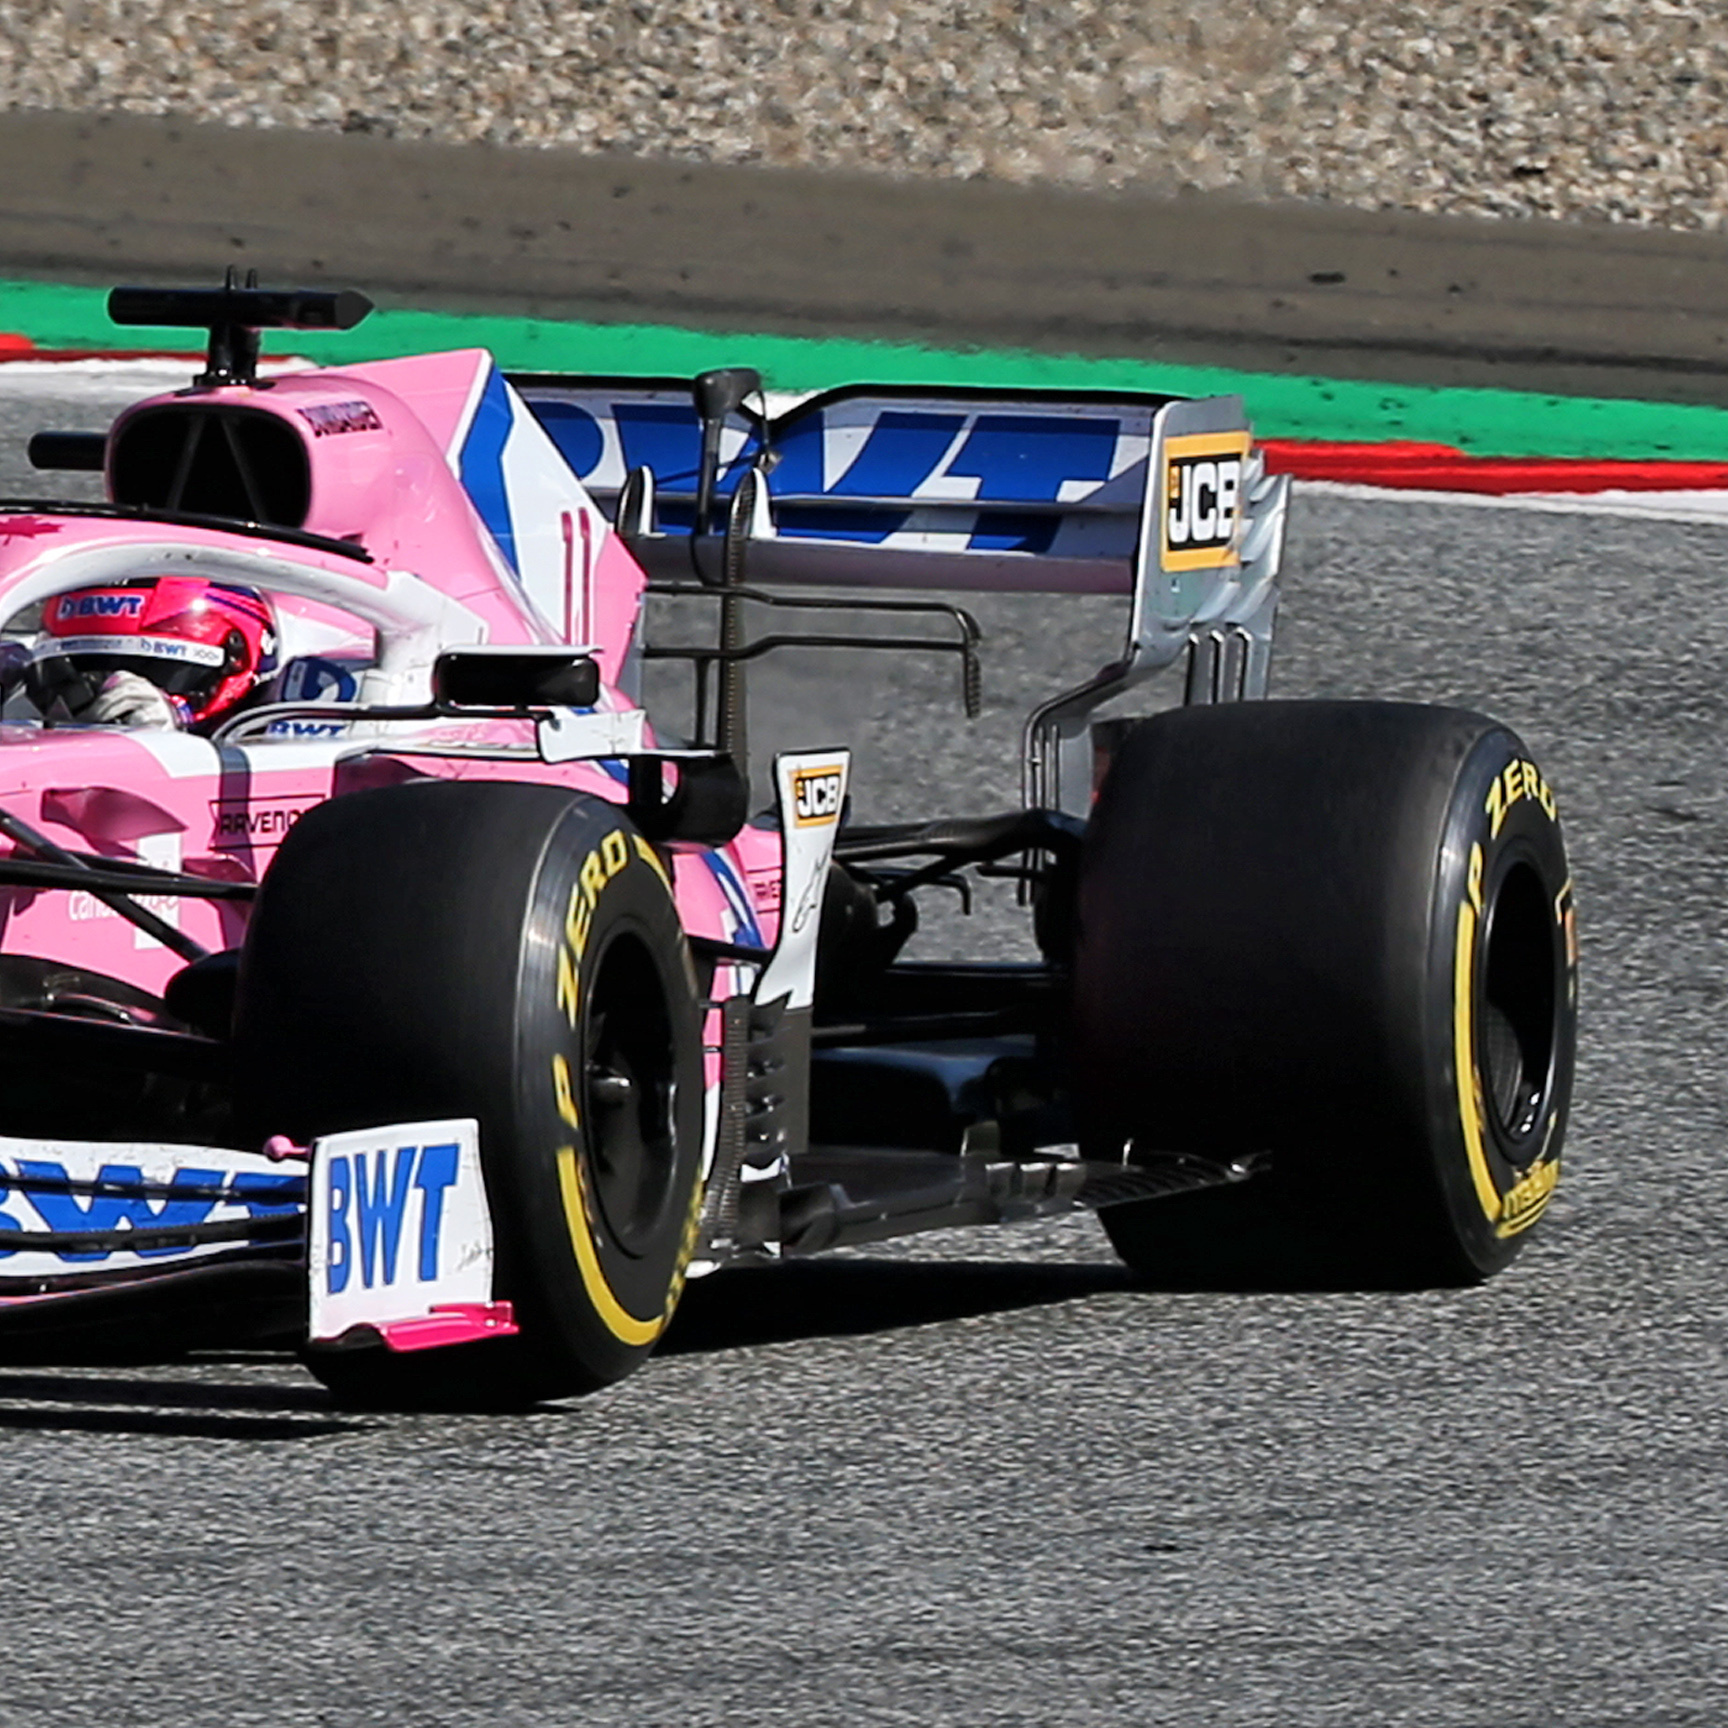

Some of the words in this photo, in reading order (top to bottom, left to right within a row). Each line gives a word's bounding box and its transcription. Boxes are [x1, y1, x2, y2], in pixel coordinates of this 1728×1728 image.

[1169, 460, 1242, 543] JCB
[79, 596, 142, 615] BWT
[221, 808, 302, 835] RAVENO
[797, 775, 840, 817] JCB
[557, 829, 629, 1031] ZERO
[327, 1142, 460, 1297] BWT
